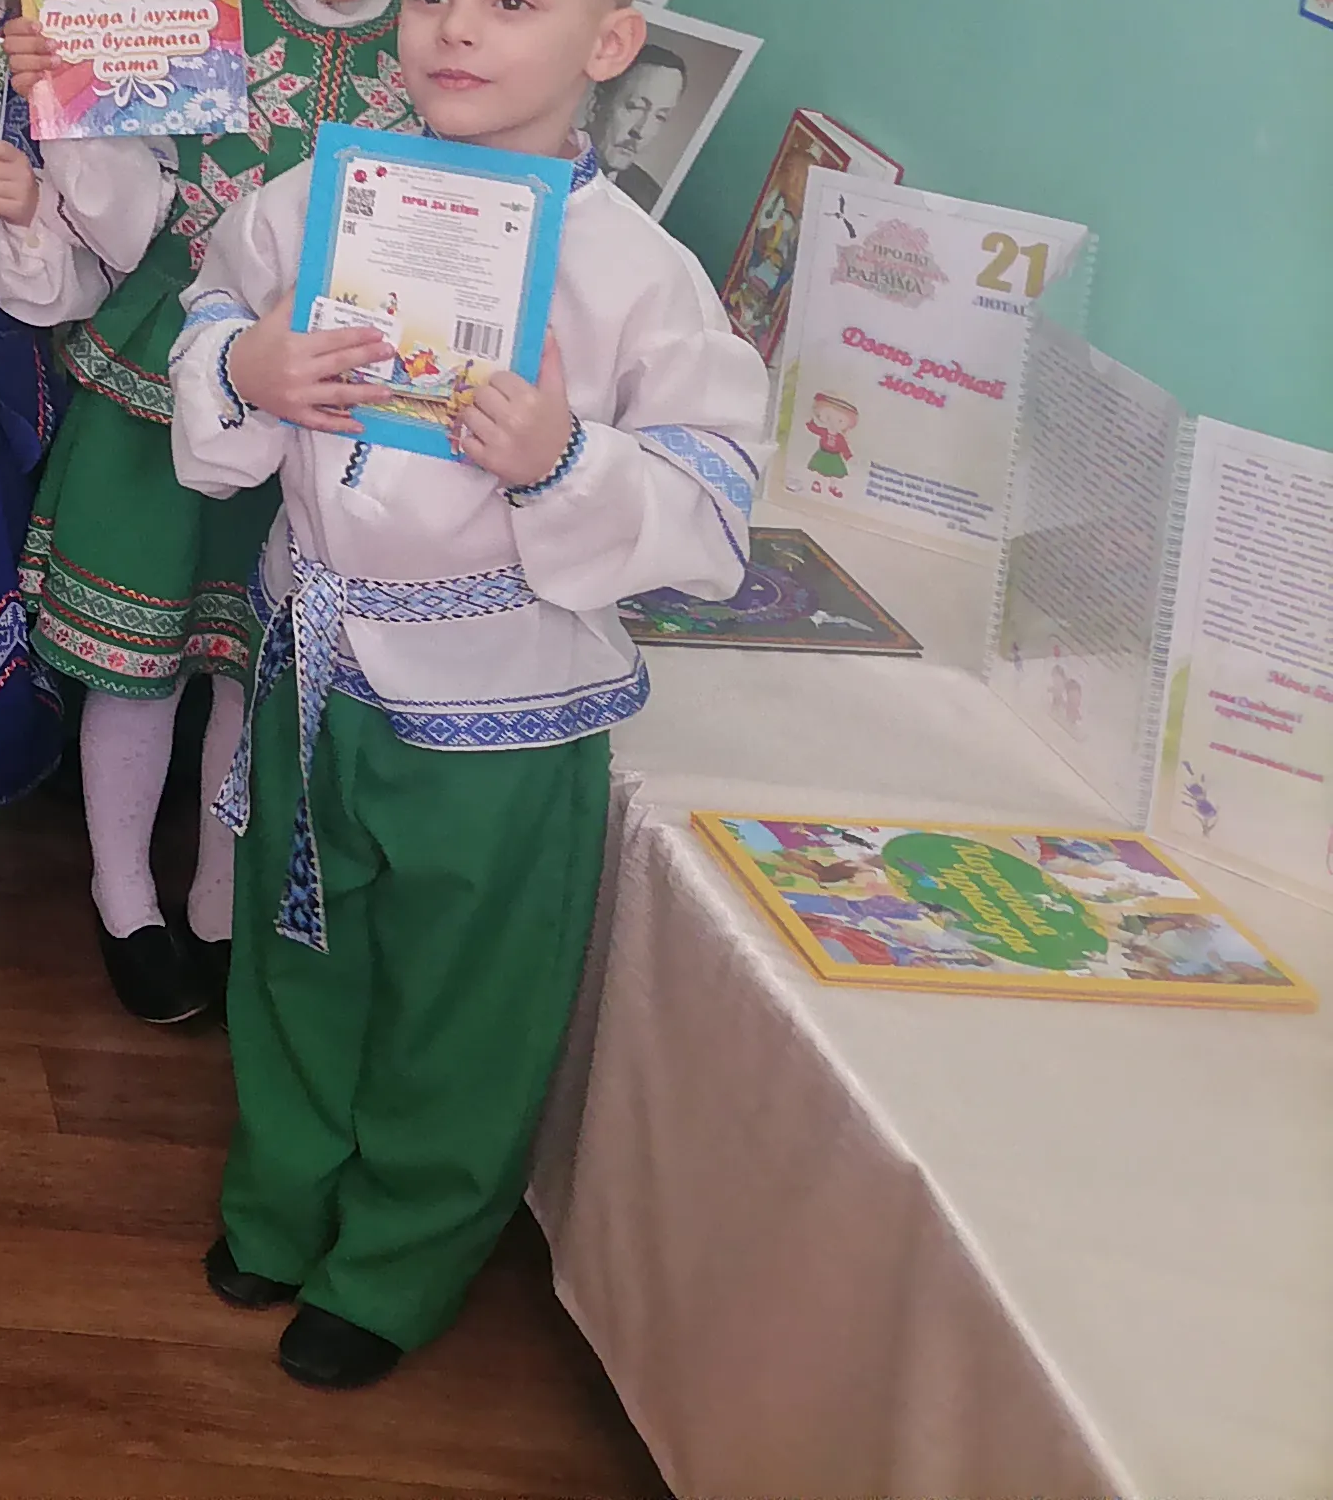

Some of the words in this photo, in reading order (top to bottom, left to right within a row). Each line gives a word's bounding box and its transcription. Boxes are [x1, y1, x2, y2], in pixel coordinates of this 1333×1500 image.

[45, 7, 123, 29] Праўда
[130, 6, 137, 23] і
[144, 8, 209, 24] лухта
[58, 37, 94, 53] пра
[102, 31, 201, 50] вусатага
[102, 58, 159, 73] ката
[976, 231, 1049, 299] 21
[878, 374, 947, 409] мовы
[913, 359, 1007, 400] роднай
